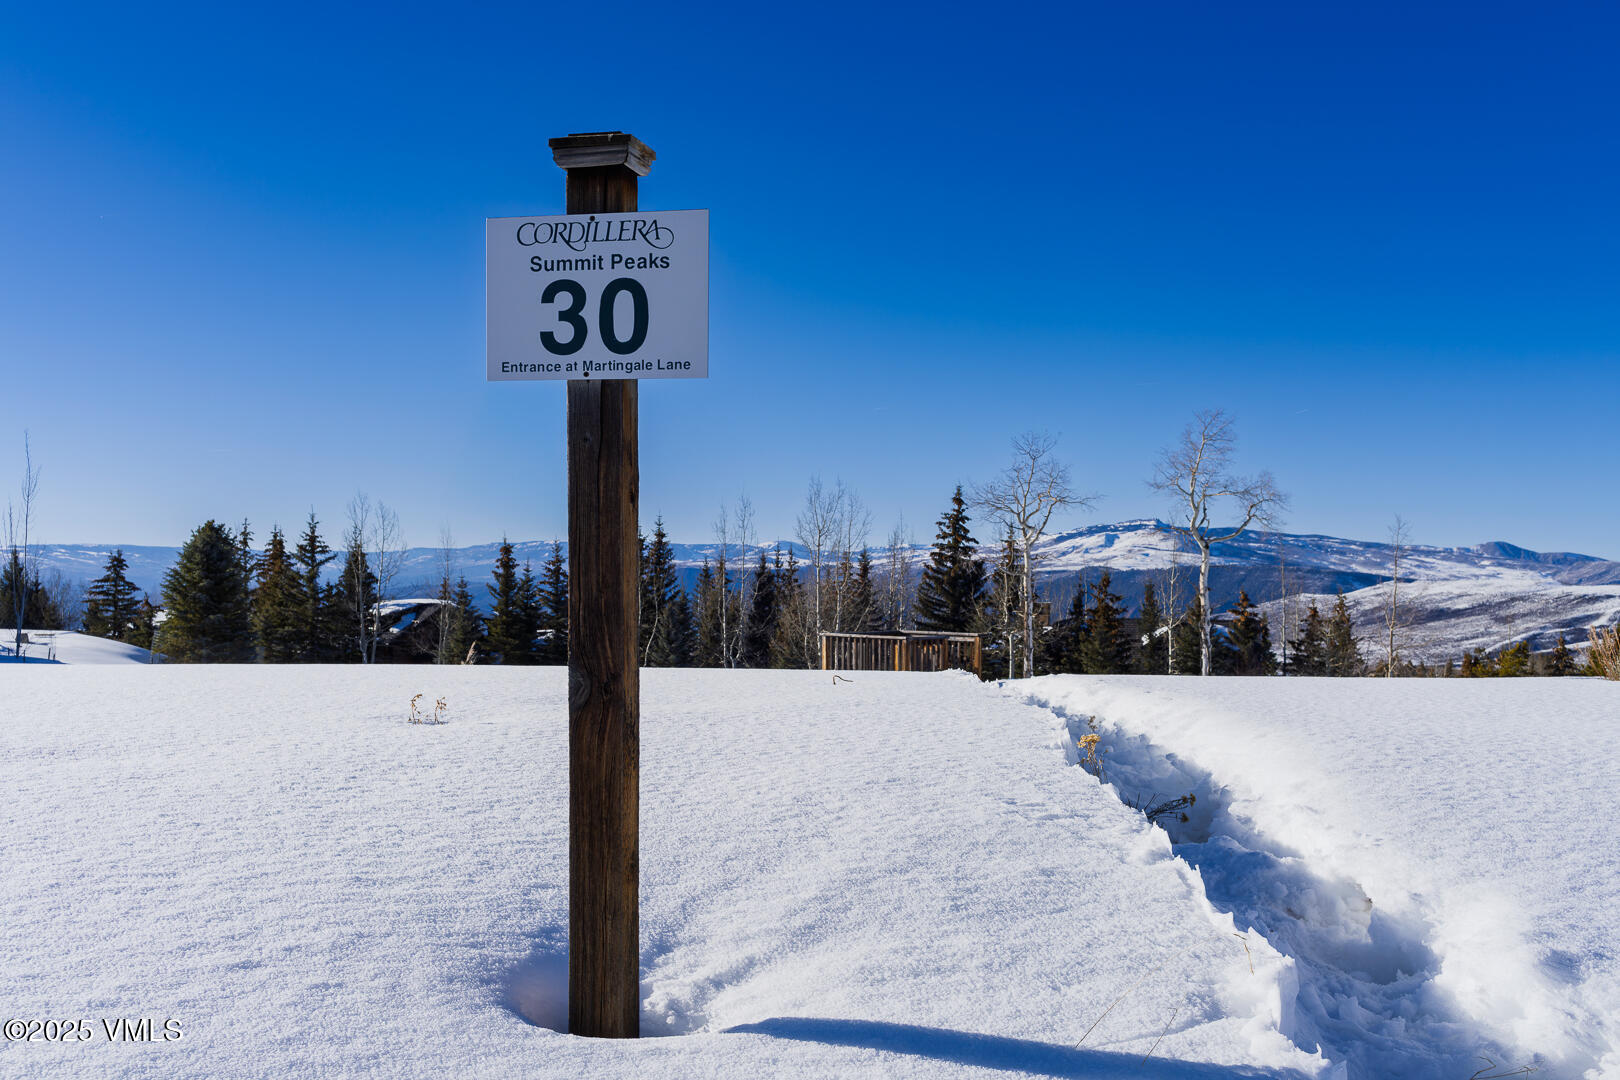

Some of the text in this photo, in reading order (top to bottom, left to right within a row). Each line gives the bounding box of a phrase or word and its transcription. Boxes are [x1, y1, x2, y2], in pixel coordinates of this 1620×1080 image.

[516, 219, 675, 252] CORDILLERA
[530, 252, 671, 273] Summit Peaks
[539, 277, 650, 356] 30
[501, 358, 692, 374] Entrance at Martingale Lane
